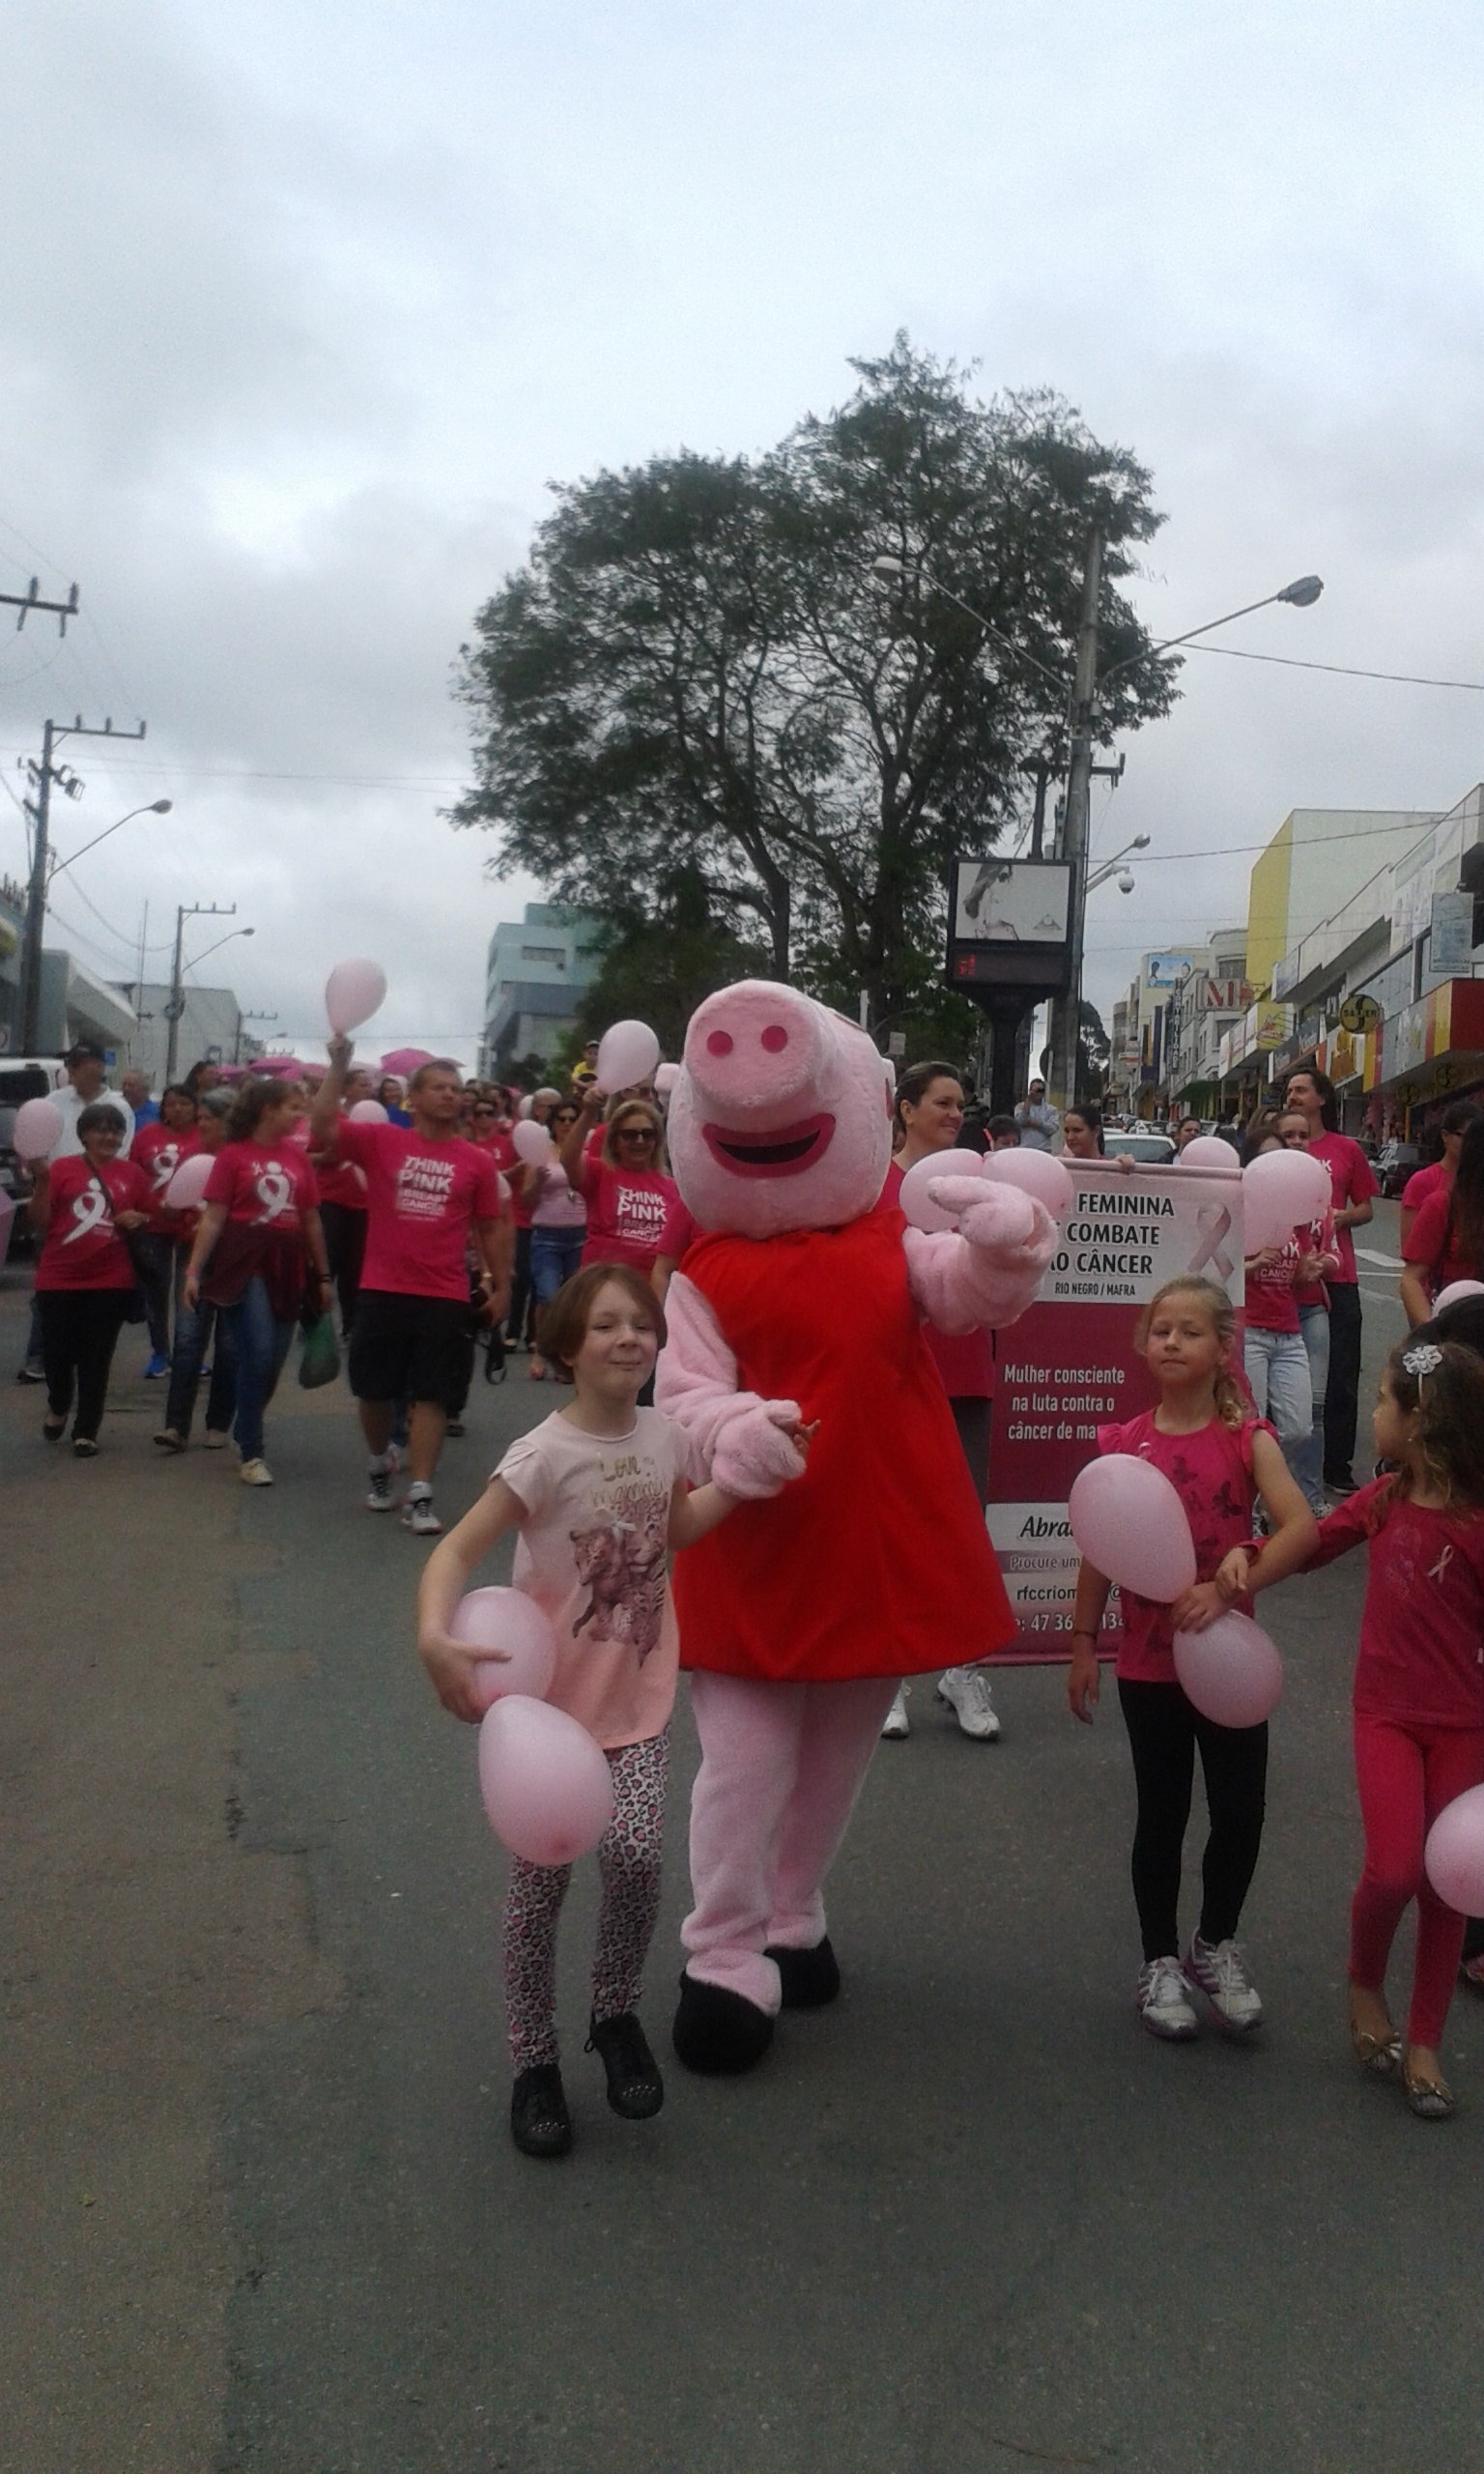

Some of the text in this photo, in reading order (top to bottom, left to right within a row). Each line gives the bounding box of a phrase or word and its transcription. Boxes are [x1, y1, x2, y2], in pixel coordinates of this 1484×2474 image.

[405, 1155, 456, 1177] THINK
[398, 1169, 453, 1194] PINK
[617, 1185, 667, 1207] THINK
[1078, 1193, 1175, 1217] FEMININA
[616, 1194, 668, 1223] PINK
[623, 1219, 667, 1232] BREAST
[1067, 1222, 1160, 1246] COMBATE
[1076, 1248, 1153, 1275] CÂNCER
[1055, 1281, 1070, 1295] RIO
[1071, 1282, 1099, 1296] NEGRO
[1106, 1283, 1136, 1296] MAFRA
[1004, 1364, 1125, 1384] Mulher consciente
[1012, 1393, 1115, 1412] na luta contra o
[1008, 1421, 1054, 1440] câncer
[1056, 1421, 1073, 1440] de
[1011, 1553, 1058, 1570] Procure
[1031, 1614, 1049, 1631] 47
[1054, 1613, 1073, 1630] 36
